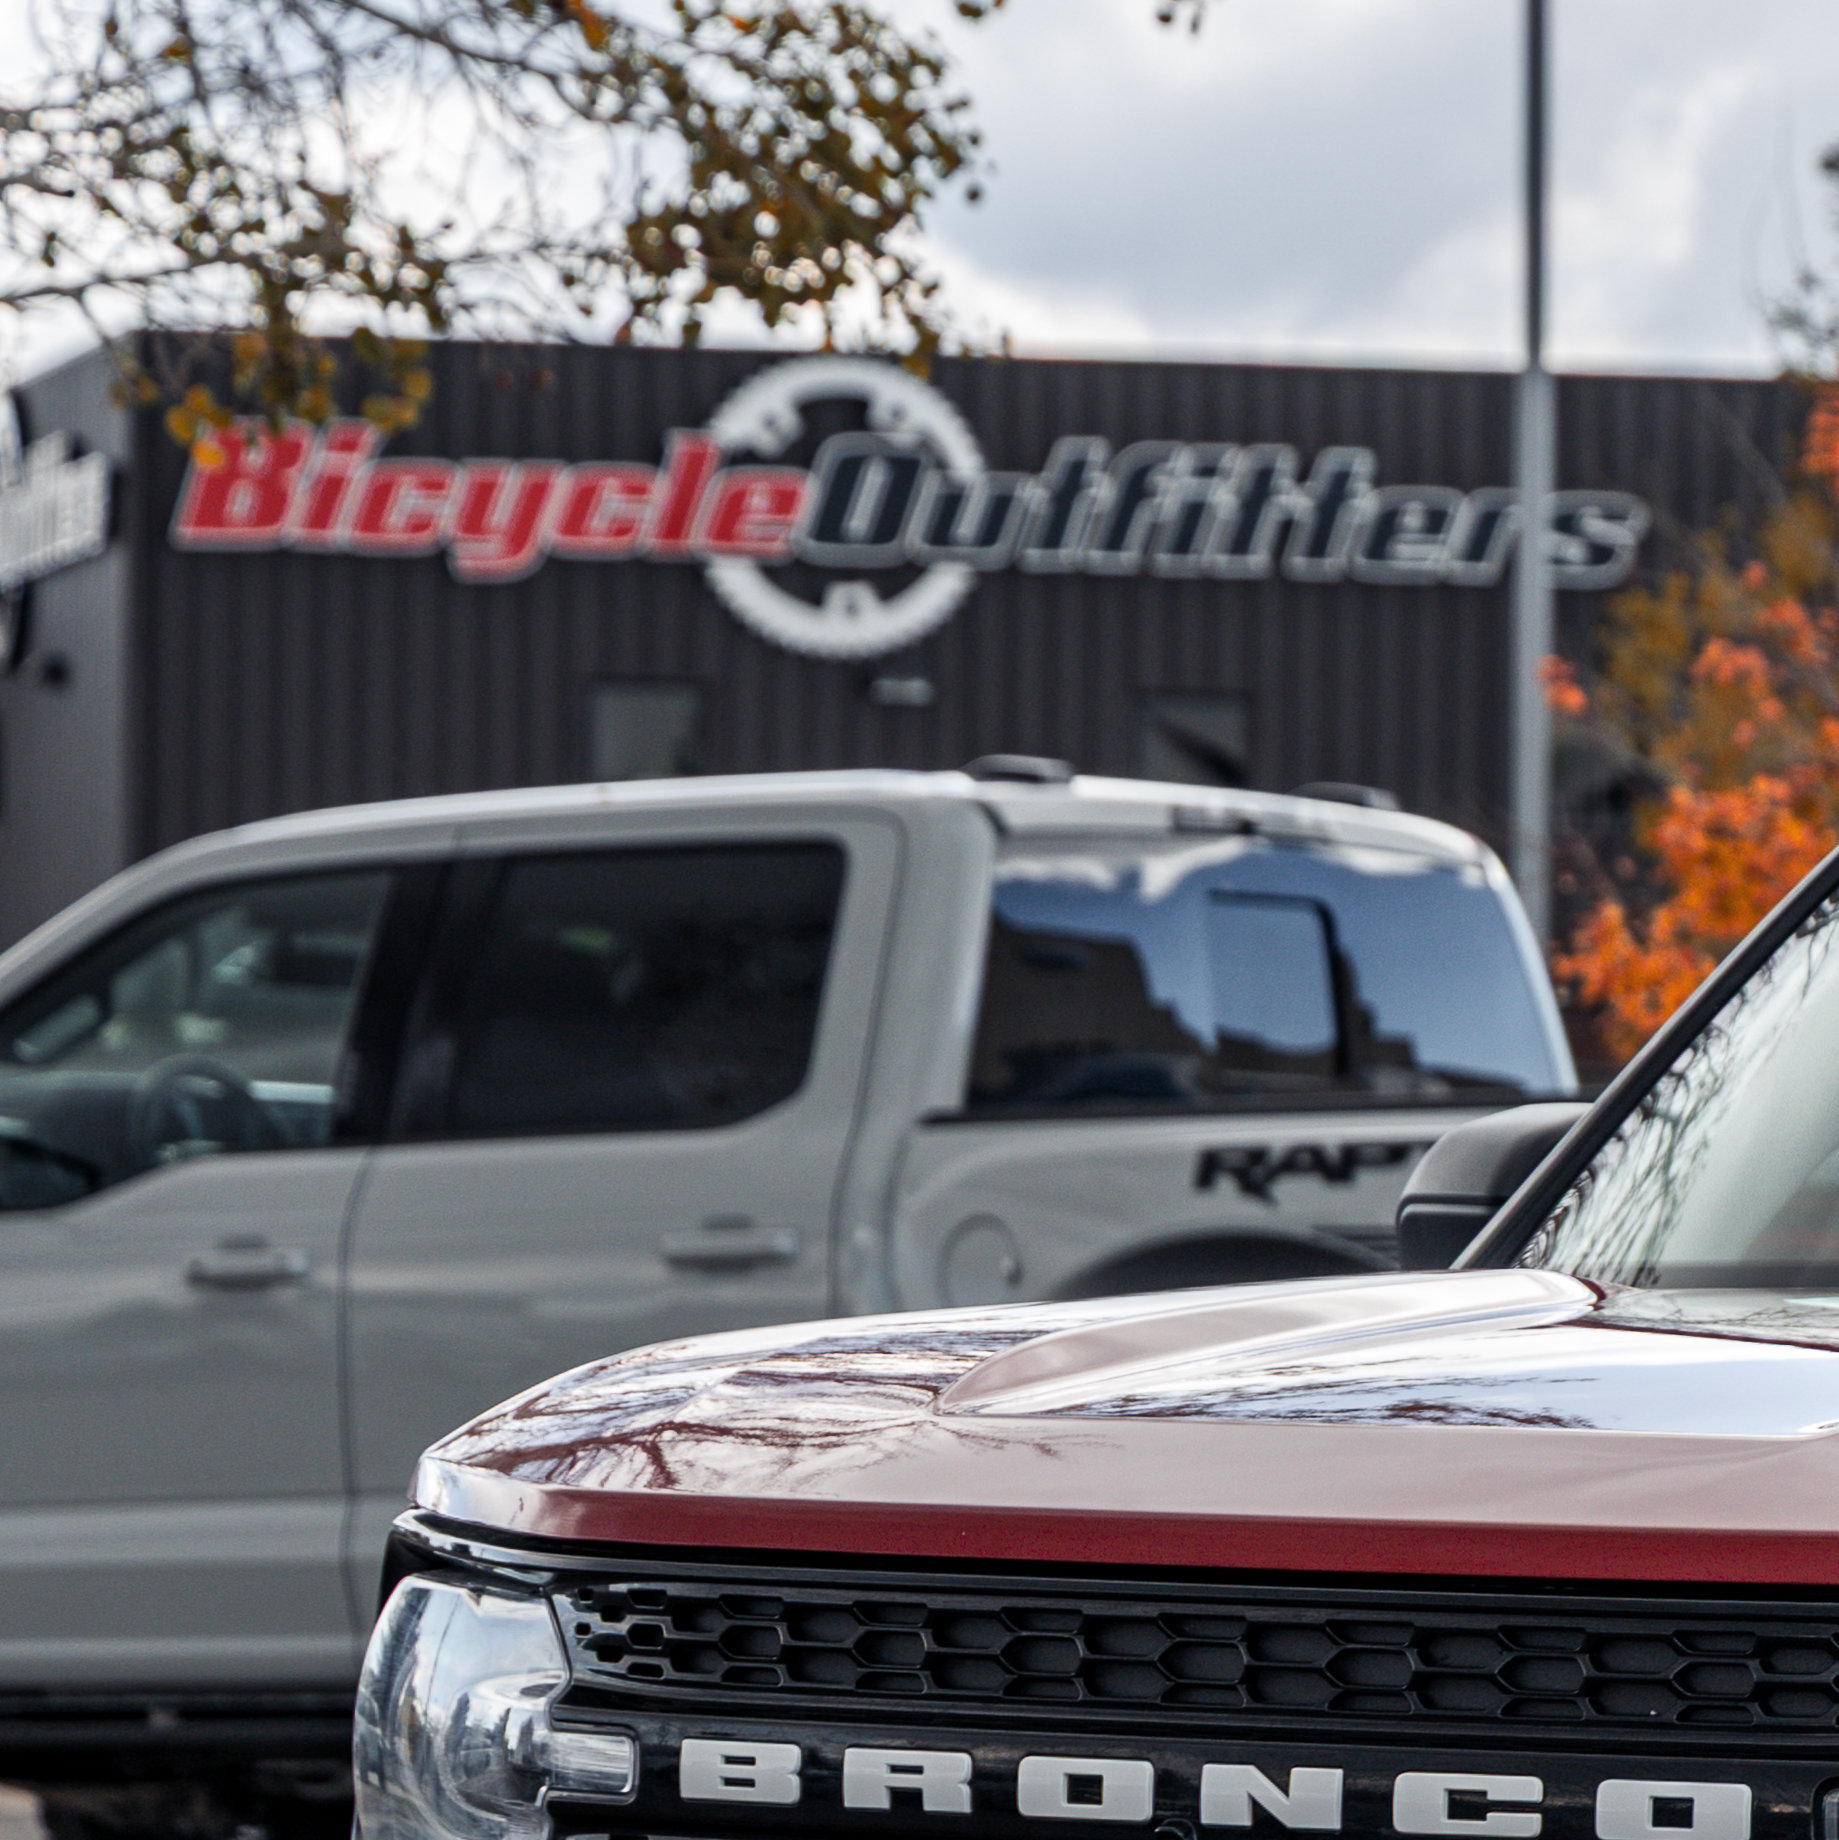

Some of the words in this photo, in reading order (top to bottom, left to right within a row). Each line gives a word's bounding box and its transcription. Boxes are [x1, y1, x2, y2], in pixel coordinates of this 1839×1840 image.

[168, 414, 815, 584] Bicycle
[795, 435, 1652, 589] Outfitters
[1194, 1140, 1438, 1206] RAP
